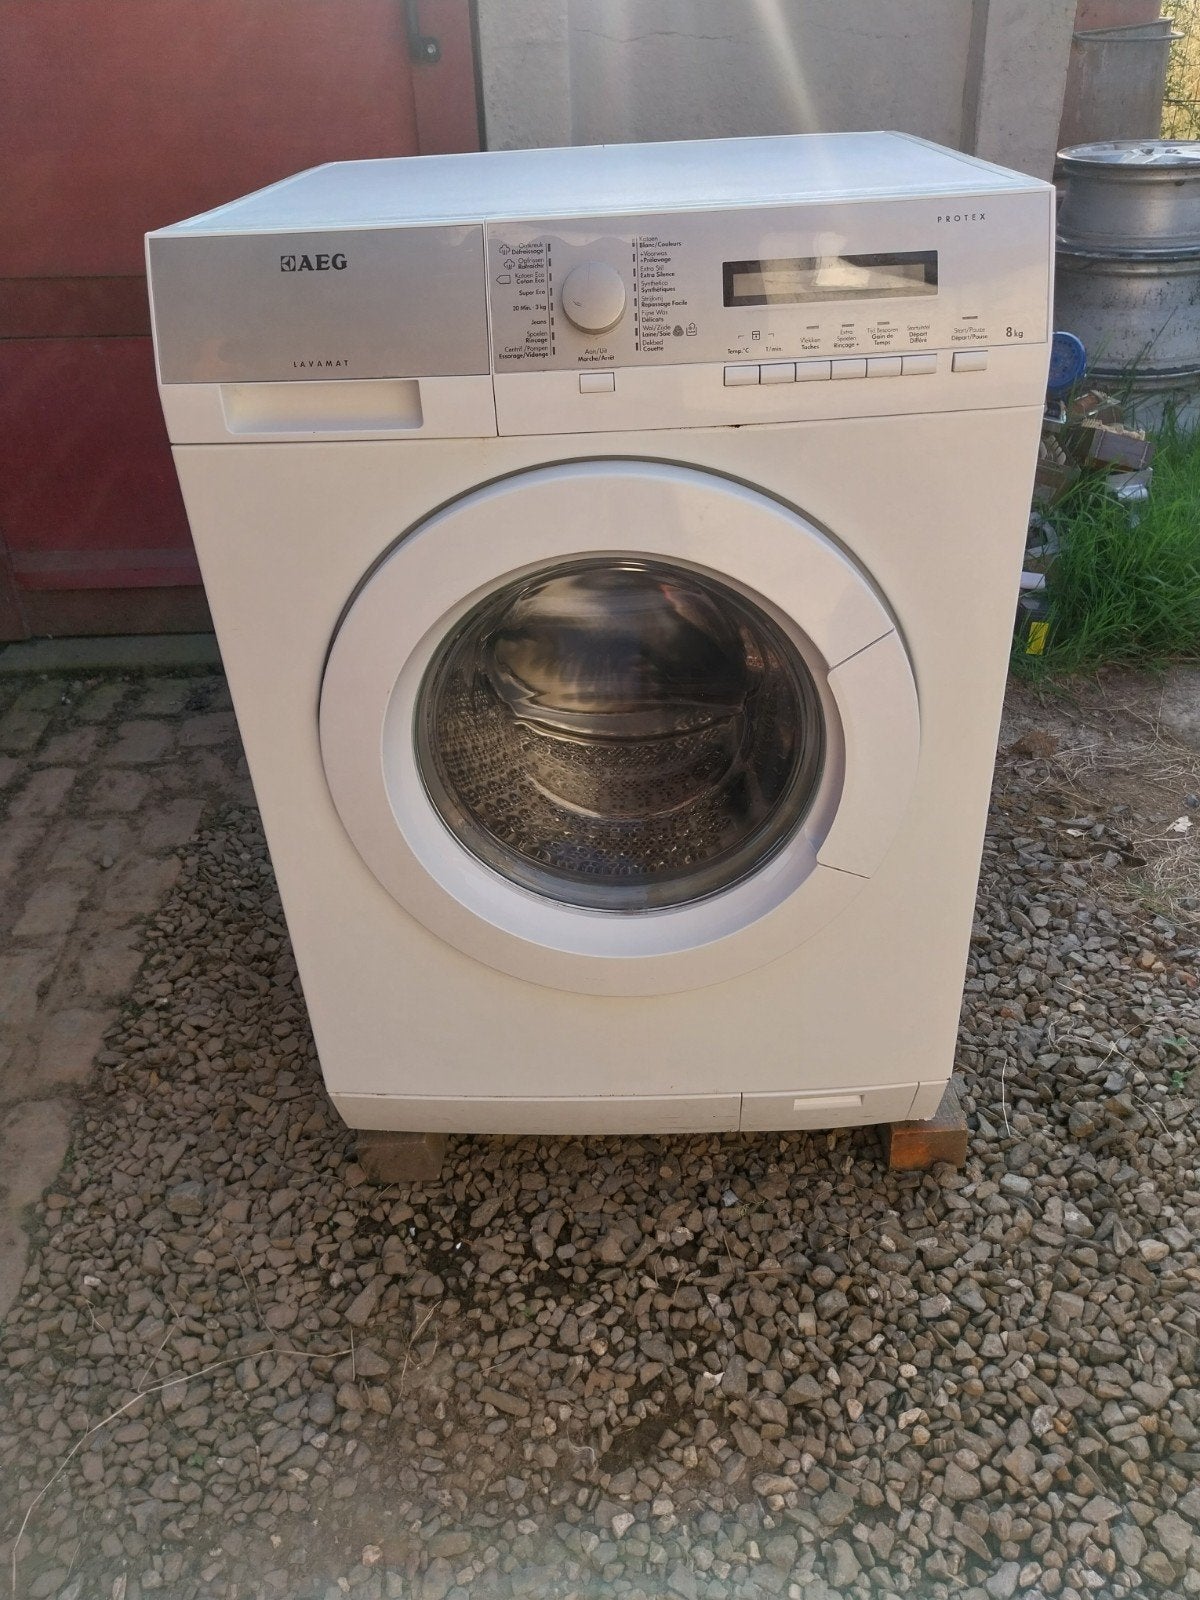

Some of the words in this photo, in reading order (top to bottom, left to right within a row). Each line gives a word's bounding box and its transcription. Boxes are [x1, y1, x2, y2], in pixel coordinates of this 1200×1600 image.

[937, 213, 986, 223] PROTEX
[298, 254, 347, 271] AEG
[1006, 327, 1012, 337] 8
[1014, 330, 1024, 338] kg
[293, 359, 349, 368] LAVAMAT
